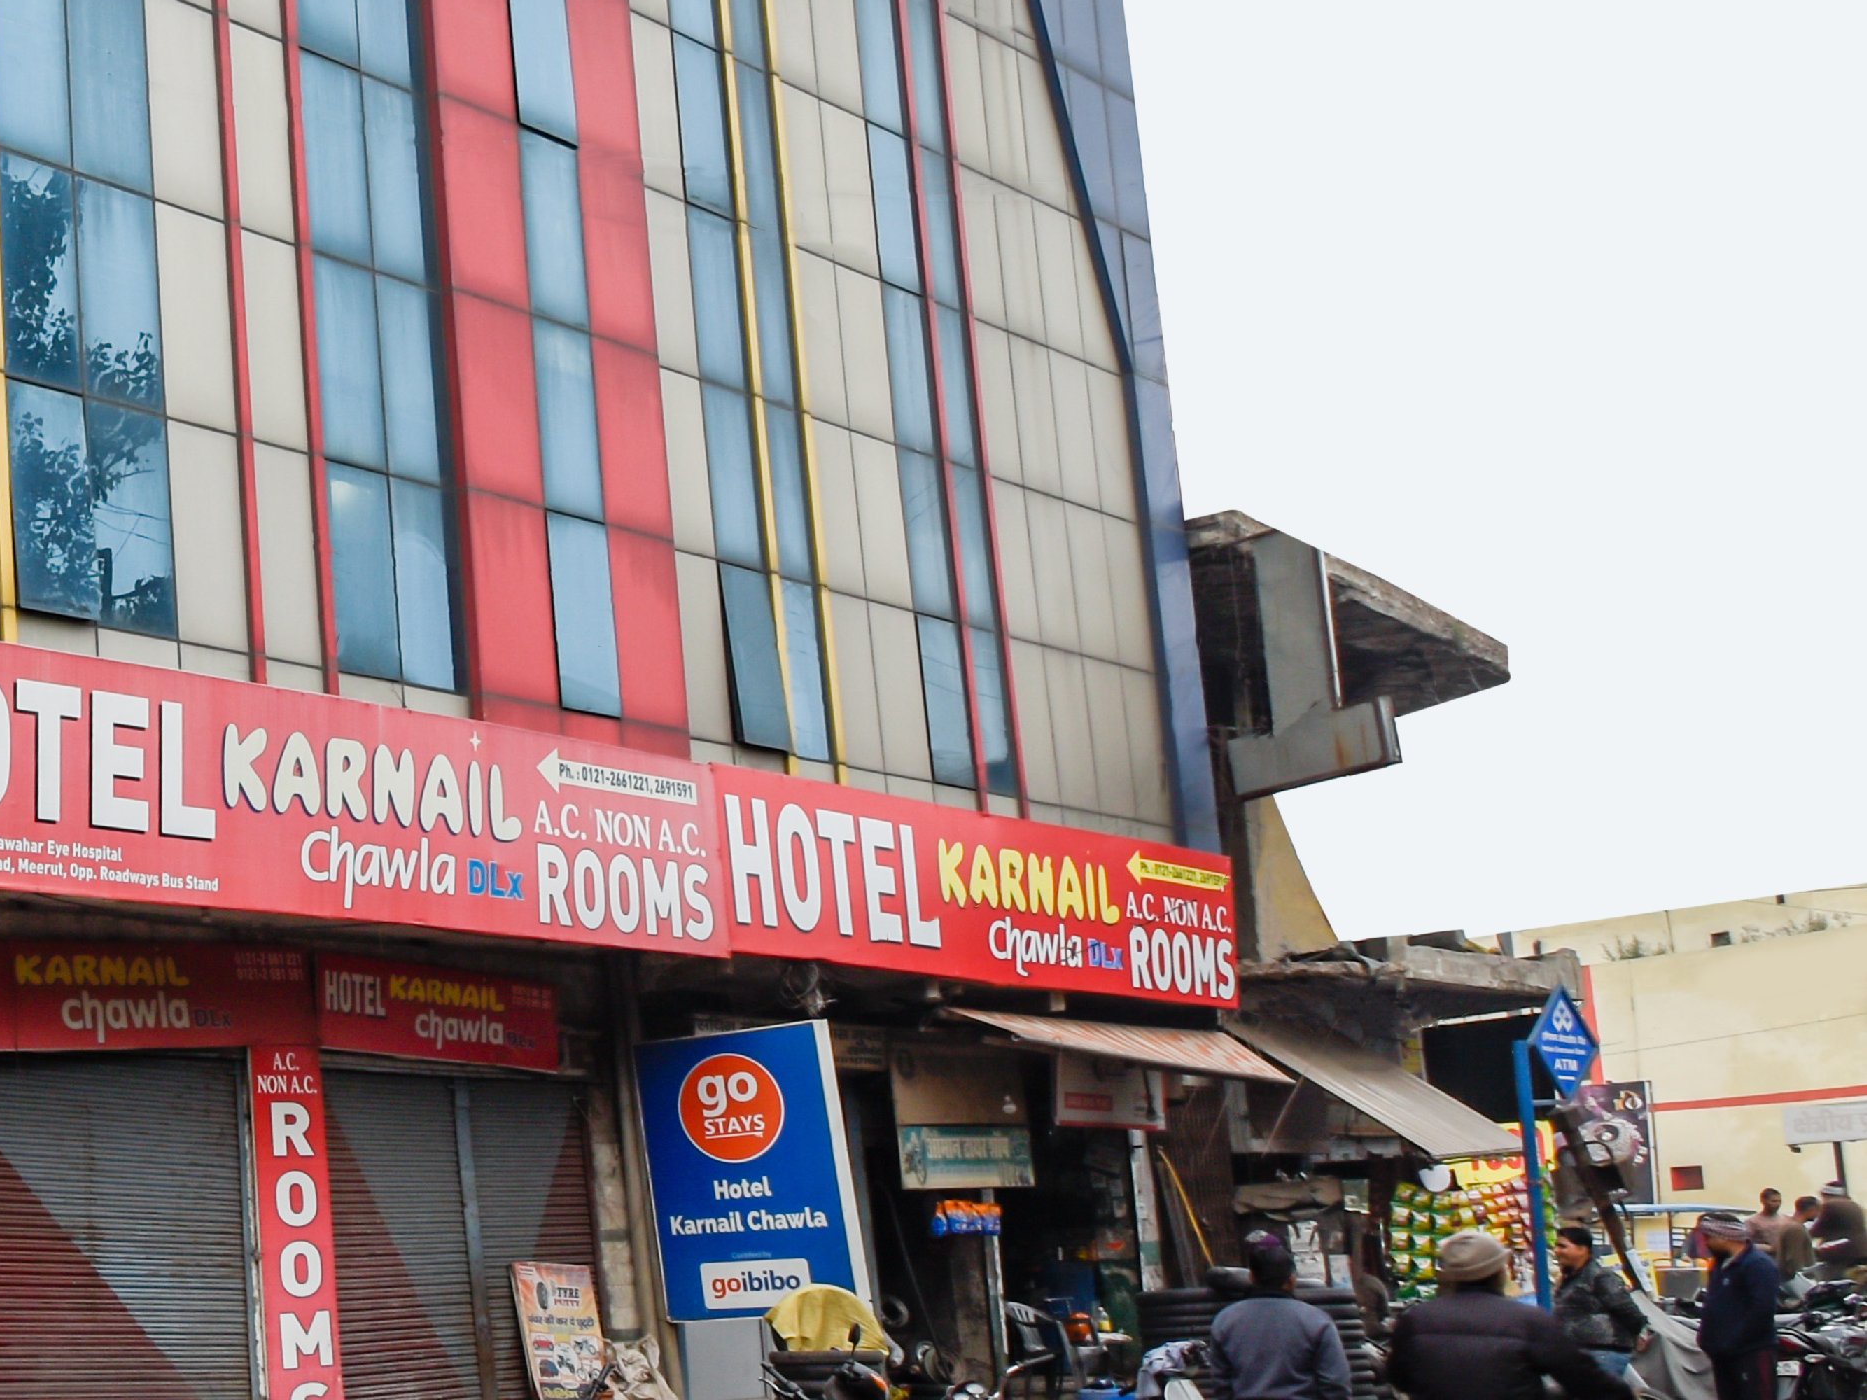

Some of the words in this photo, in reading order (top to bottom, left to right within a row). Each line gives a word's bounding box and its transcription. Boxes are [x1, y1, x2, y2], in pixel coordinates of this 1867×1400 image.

[223, 723, 522, 842] KARNAIL
[534, 800, 587, 841] A.C.
[594, 808, 651, 850] NON
[658, 818, 707, 858] A.C.
[47, 839, 69, 858] Eye
[72, 842, 122, 862] Hospital
[301, 826, 456, 908] Chawla
[18, 858, 67, 879] Meerut,
[70, 863, 97, 882] Opp.
[100, 866, 159, 888] Roadways
[162, 872, 183, 889] Bus
[185, 875, 219, 892] Stand
[724, 793, 942, 949] HOTEL
[938, 838, 1120, 924] KARNAIL
[537, 843, 715, 941] ROOMS
[1126, 891, 1159, 921] A.C.
[1163, 896, 1198, 928] NON
[1202, 903, 1232, 933] A.C.
[989, 916, 1083, 977] Chawla
[1129, 925, 1235, 1000] ROOMS
[15, 954, 190, 986] KARNAIL
[324, 970, 386, 1016] HOTEL
[390, 973, 505, 1012] KARNAIL
[273, 1052, 300, 1071] A.C.
[1554, 1058, 1579, 1072] ATM
[257, 1075, 287, 1094] NON
[290, 1075, 318, 1094] A.C.
[697, 1071, 758, 1117] go
[704, 1113, 766, 1135] STAYS
[713, 1175, 773, 1200] Hotel
[670, 1211, 745, 1236] Karnail
[747, 1206, 828, 1232] Chawla
[557, 1286, 580, 1299] TYRE
[712, 1269, 801, 1299] goibibo
